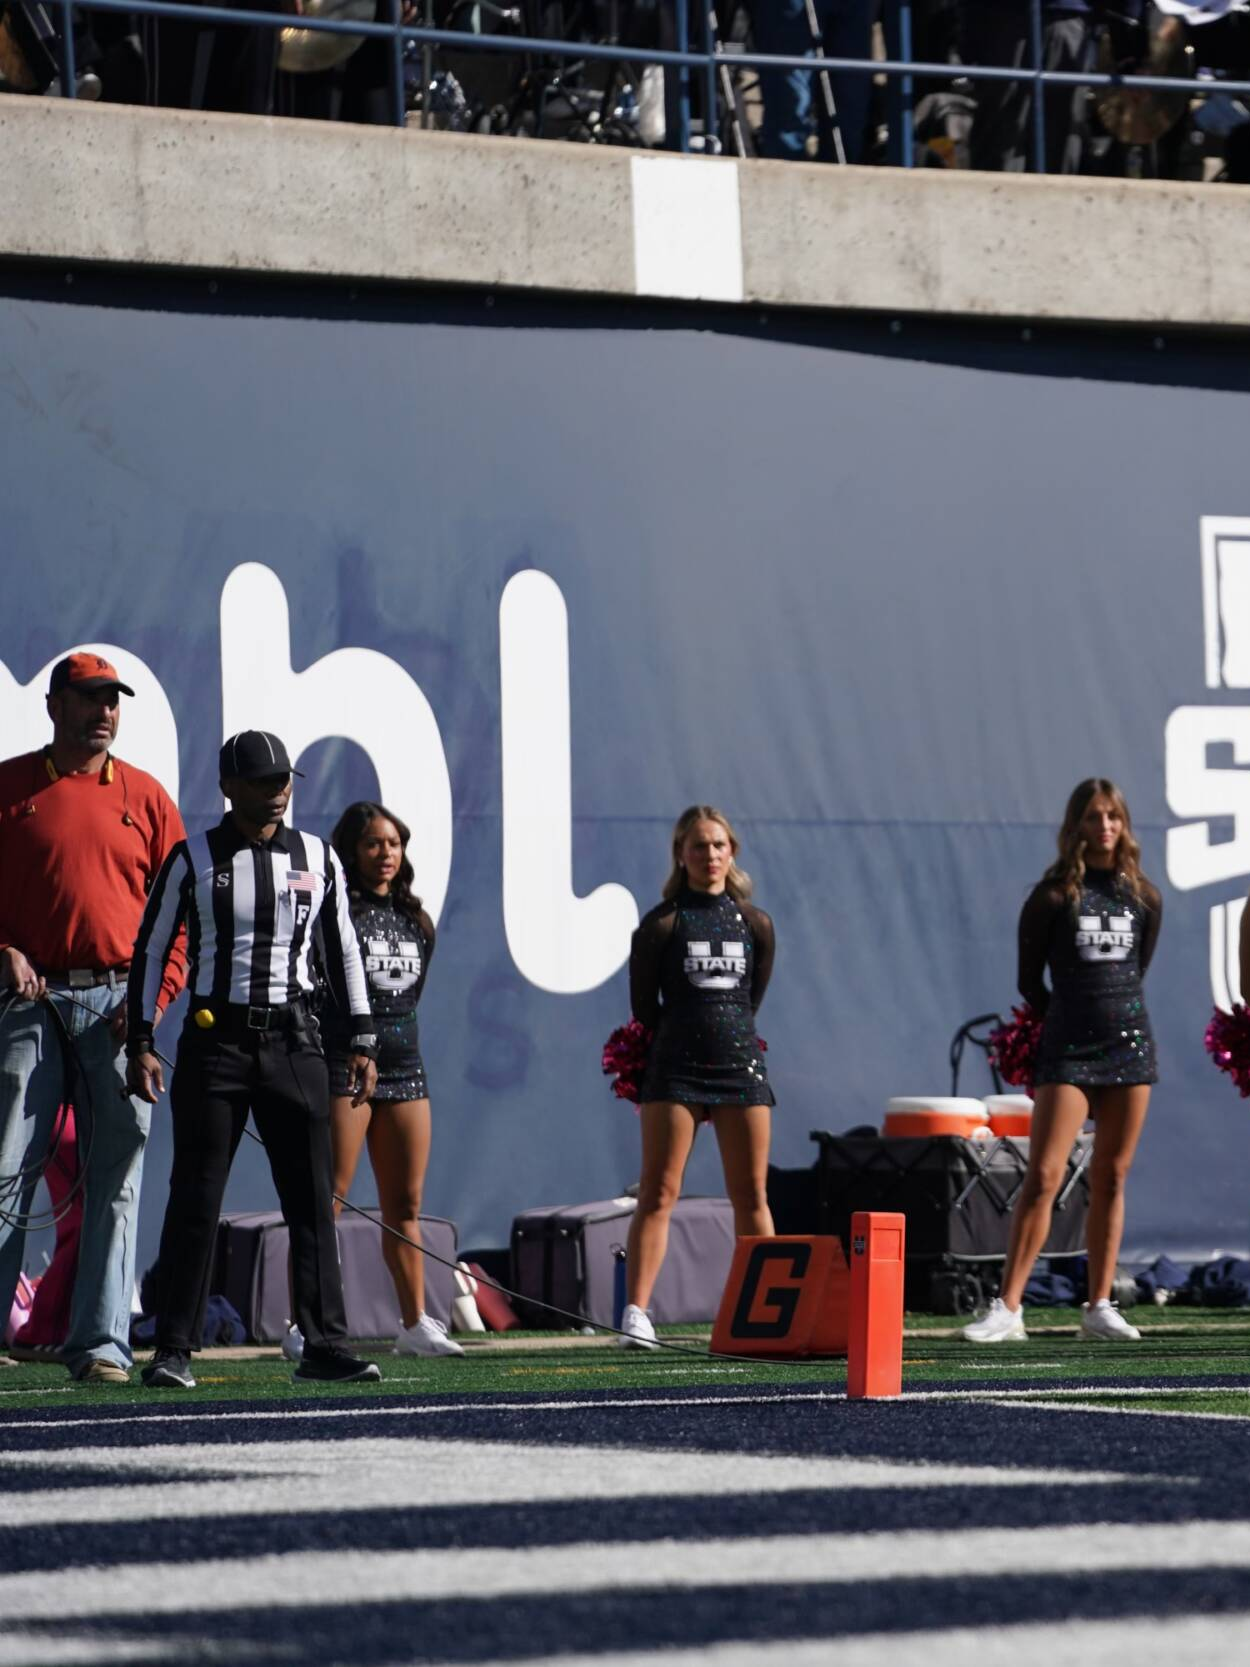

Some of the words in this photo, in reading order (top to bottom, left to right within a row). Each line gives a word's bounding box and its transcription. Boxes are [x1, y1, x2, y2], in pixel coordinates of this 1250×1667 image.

[296, 904, 309, 925] F
[1076, 931, 1134, 948] STATE
[365, 955, 421, 976] STATE
[684, 956, 747, 975] STATE
[730, 1242, 812, 1340] G
